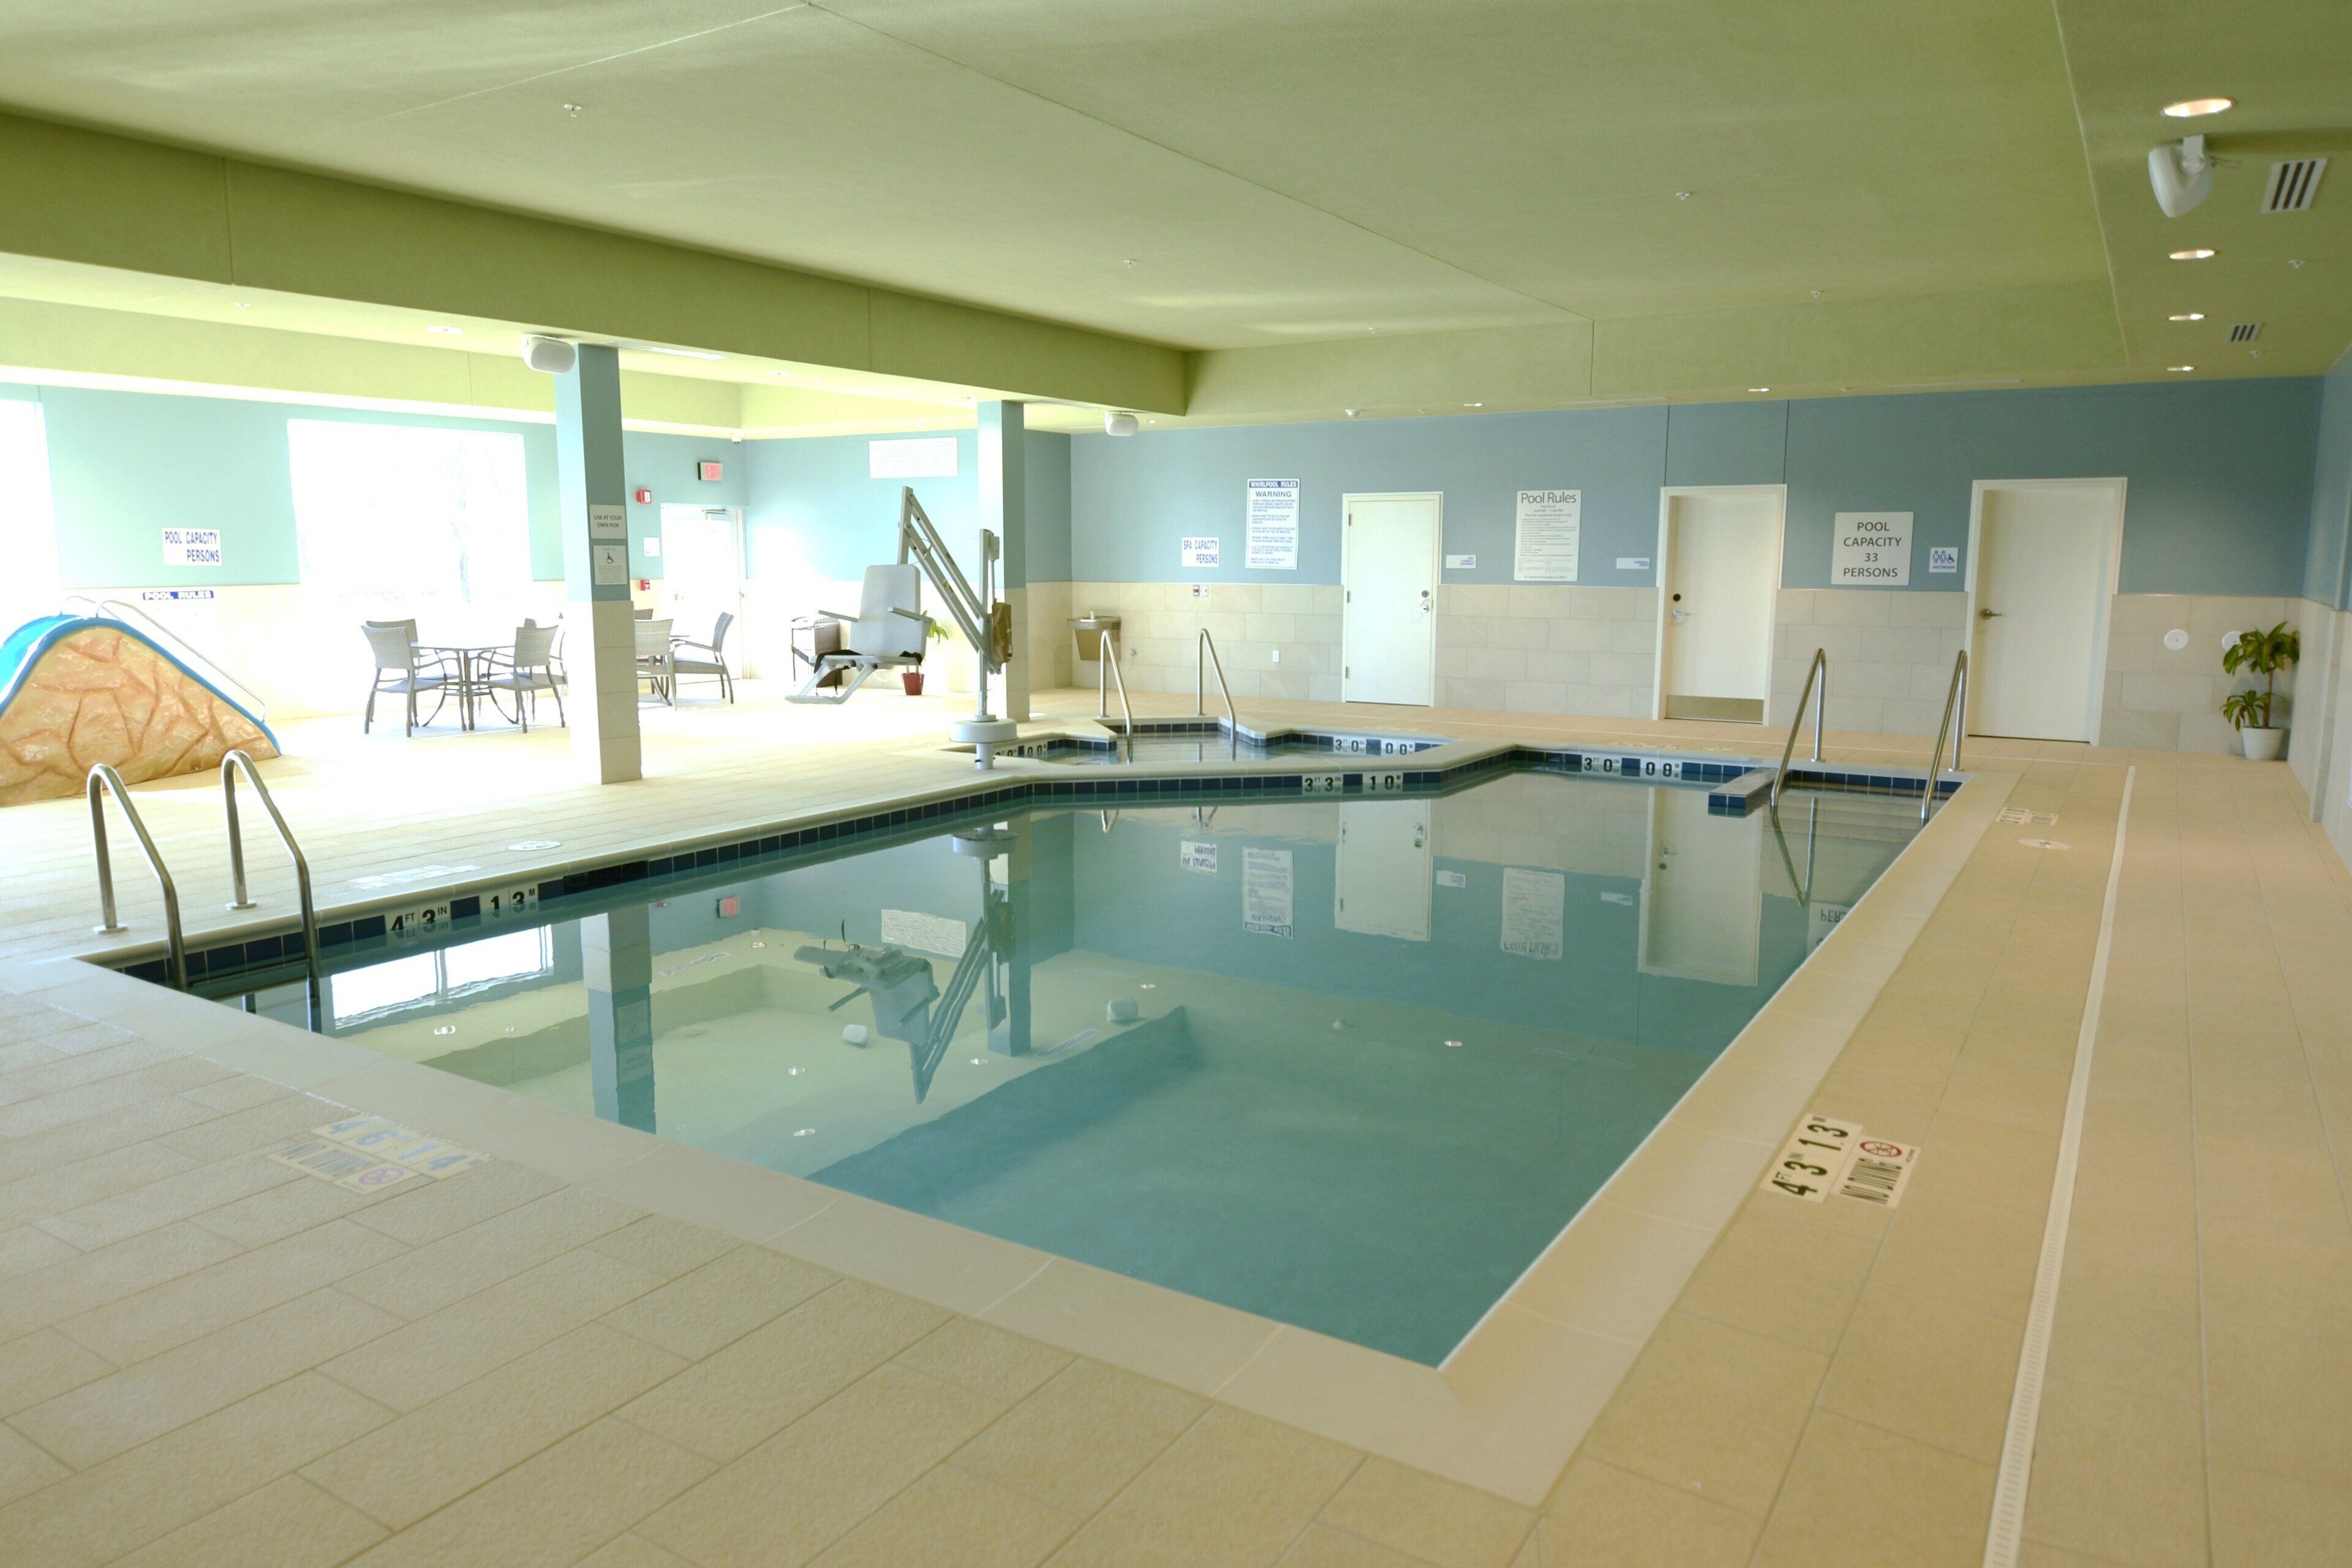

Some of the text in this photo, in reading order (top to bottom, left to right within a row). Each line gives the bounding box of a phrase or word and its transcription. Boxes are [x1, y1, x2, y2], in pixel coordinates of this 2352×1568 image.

[705, 464, 720, 480] EXIT
[1521, 492, 1577, 503] Pool Rules
[1857, 522, 1890, 531] POOL
[165, 531, 217, 545] POOL CAPACITY
[1844, 537, 1902, 546] CAPACITY
[1183, 540, 1218, 549] SPA CAPACITY
[187, 549, 219, 562] PERSONS
[1196, 554, 1218, 564] PERSONS
[1864, 552, 1878, 562] 33
[1843, 567, 1898, 577] PERSONS
[145, 590, 212, 600] POOL RULES
